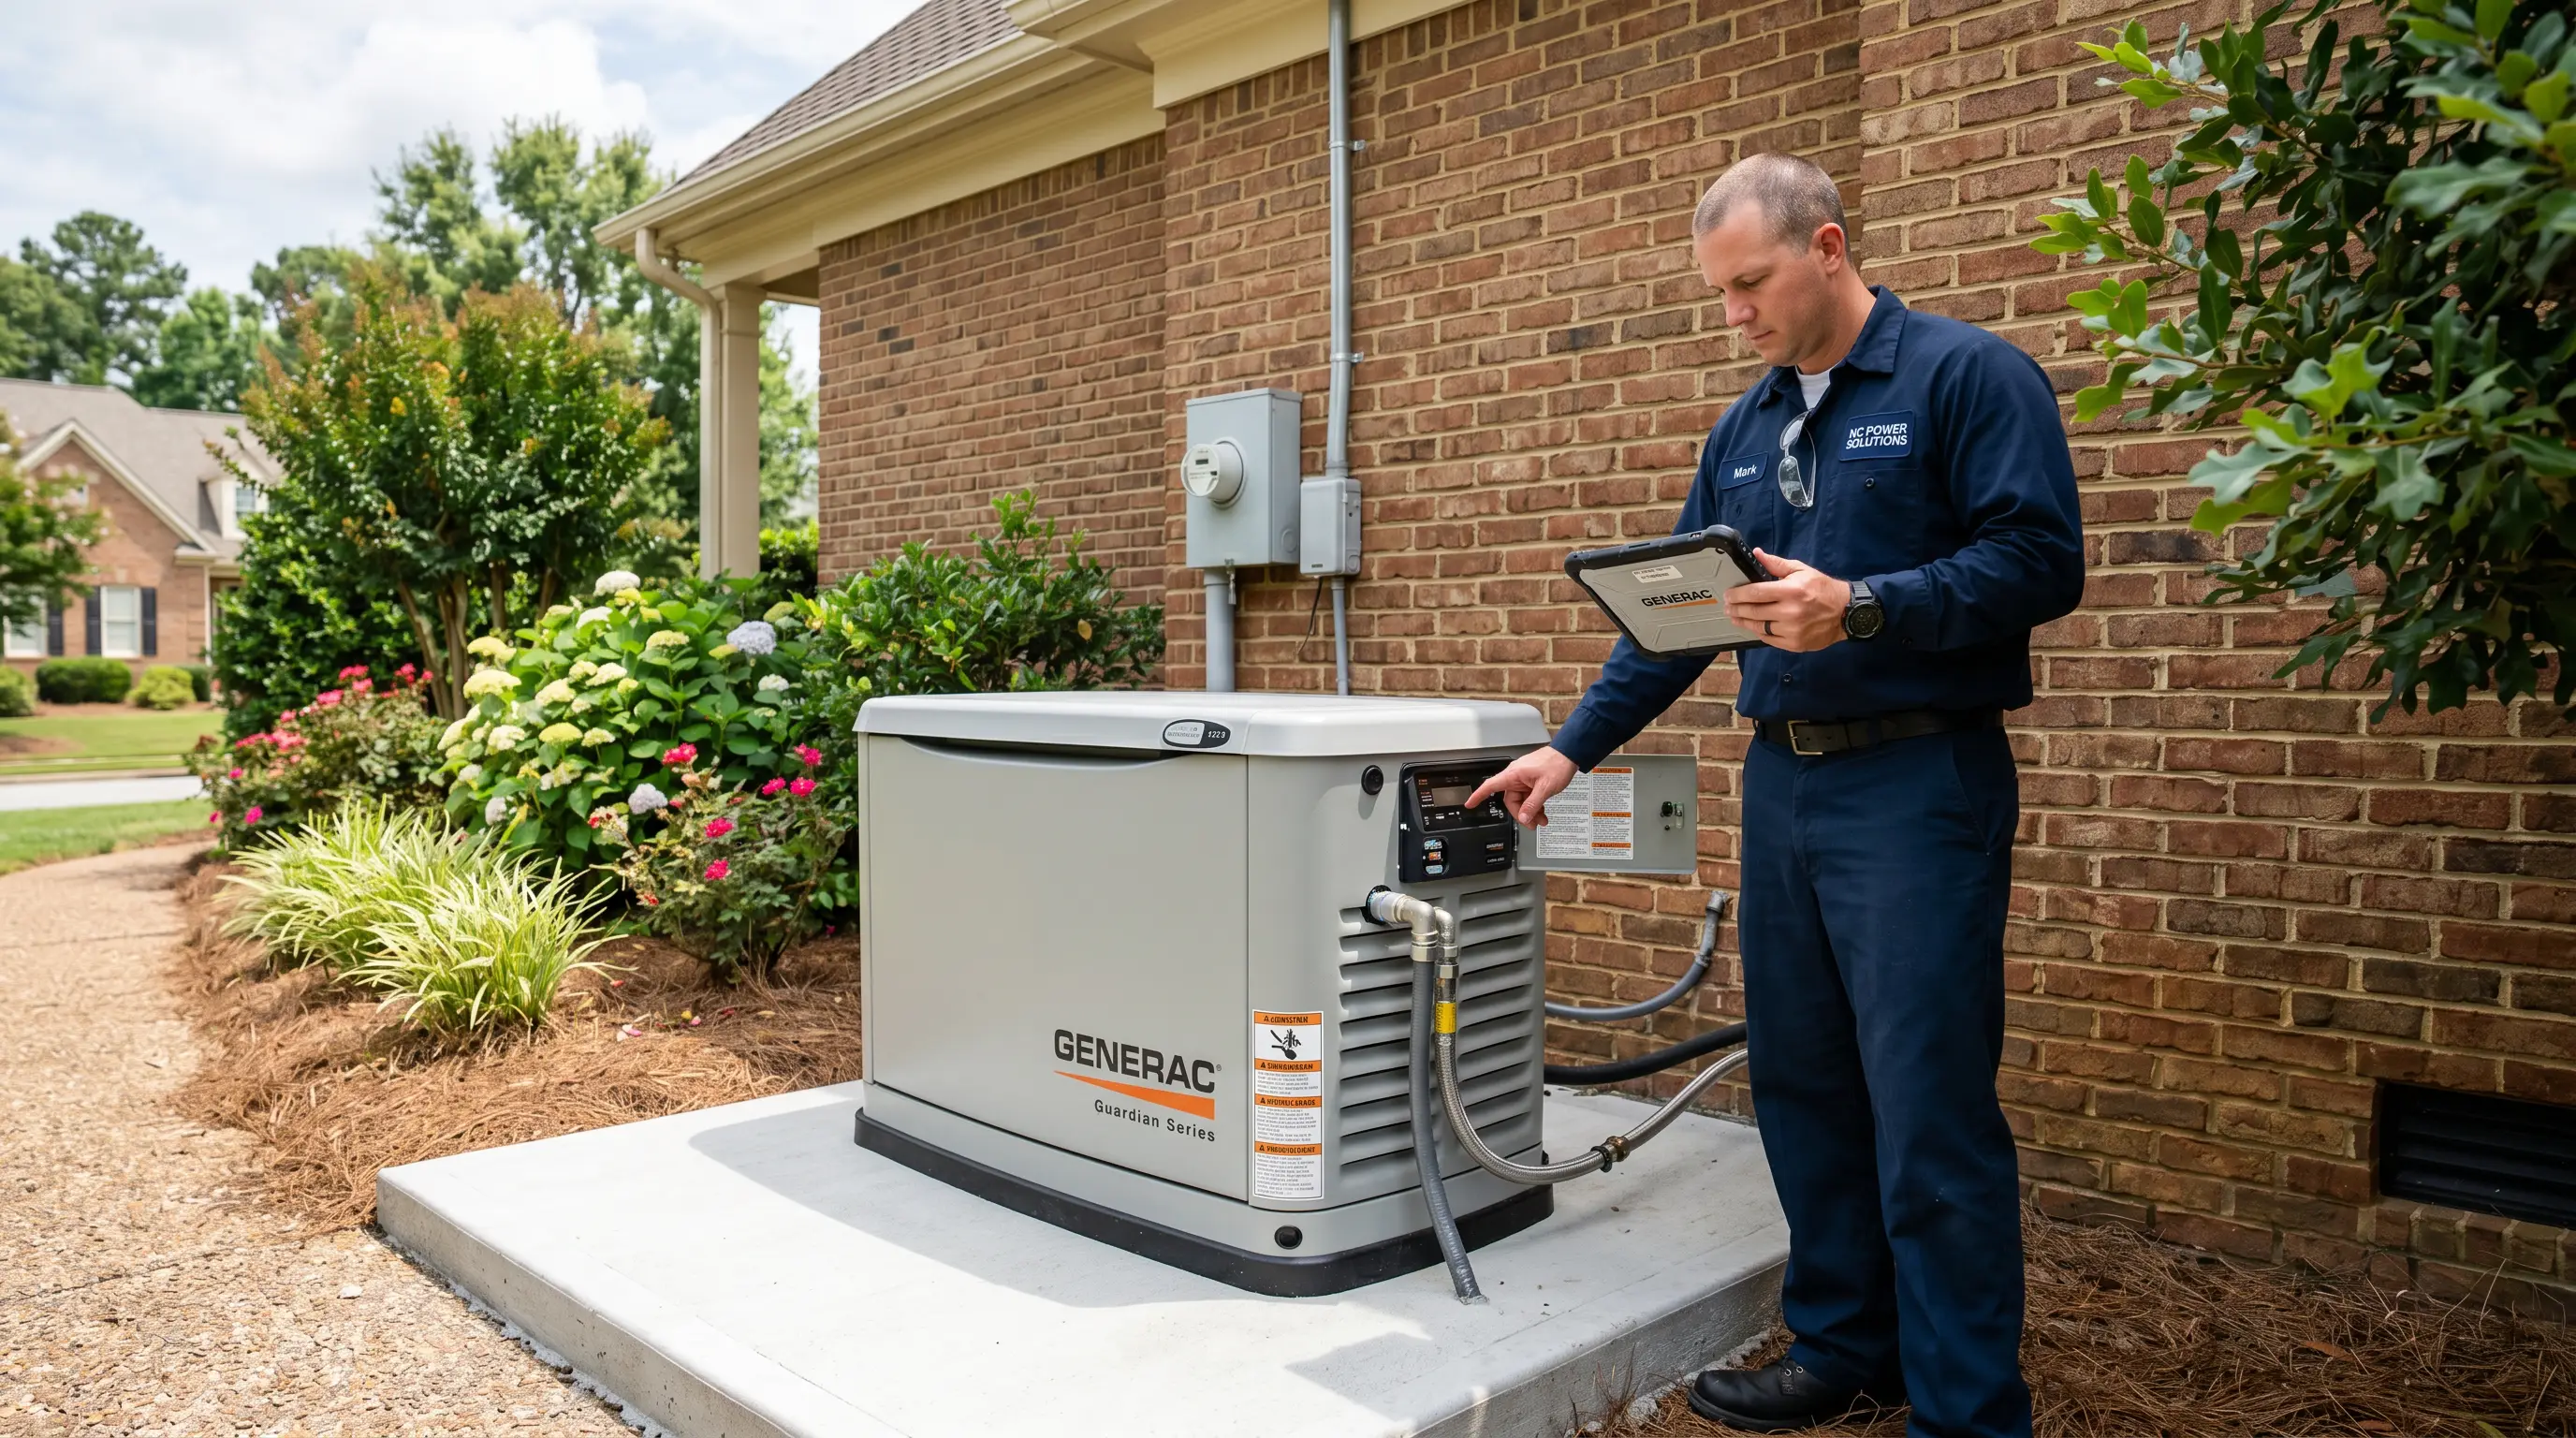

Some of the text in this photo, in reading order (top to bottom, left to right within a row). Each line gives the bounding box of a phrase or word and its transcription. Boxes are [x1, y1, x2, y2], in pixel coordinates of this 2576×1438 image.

[1849, 423, 1908, 438] NC POWER
[1846, 435, 1908, 449] SOLUTIONS
[1734, 464, 1757, 478] Mark
[1641, 590, 1713, 607] GENERAC
[1054, 1029, 1215, 1093] GENERAC
[1094, 1099, 1215, 1142] Guardian Series
